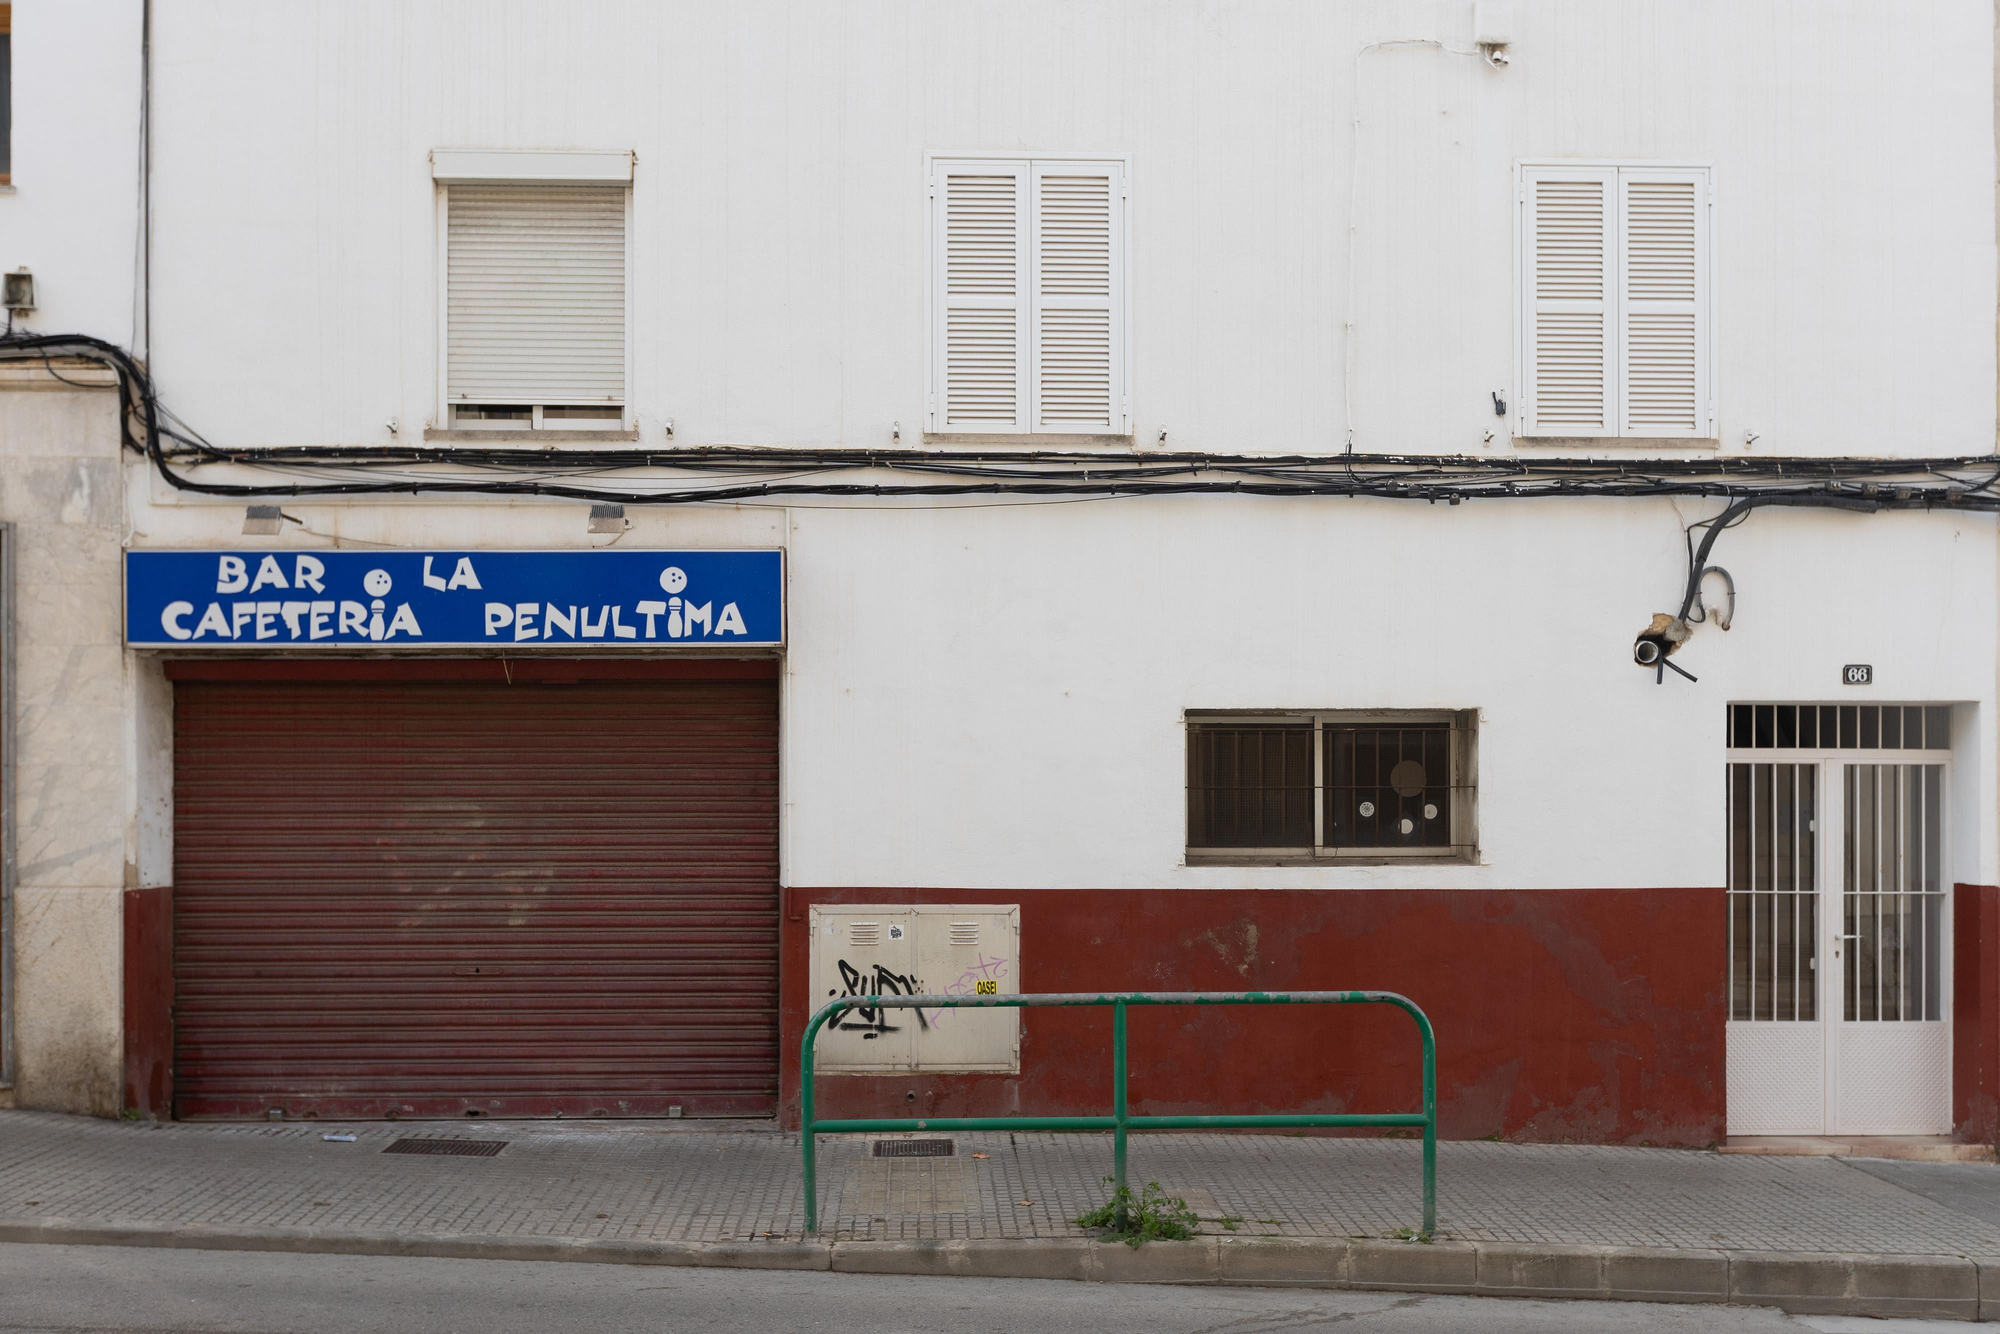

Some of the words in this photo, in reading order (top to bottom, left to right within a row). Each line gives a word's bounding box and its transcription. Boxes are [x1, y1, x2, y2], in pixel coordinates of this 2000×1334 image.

[216, 554, 326, 594] BAR
[423, 555, 482, 592] LA
[161, 600, 423, 641] CAFETERIA
[484, 597, 748, 642] PENULTIMA
[1847, 667, 1868, 682] 66
